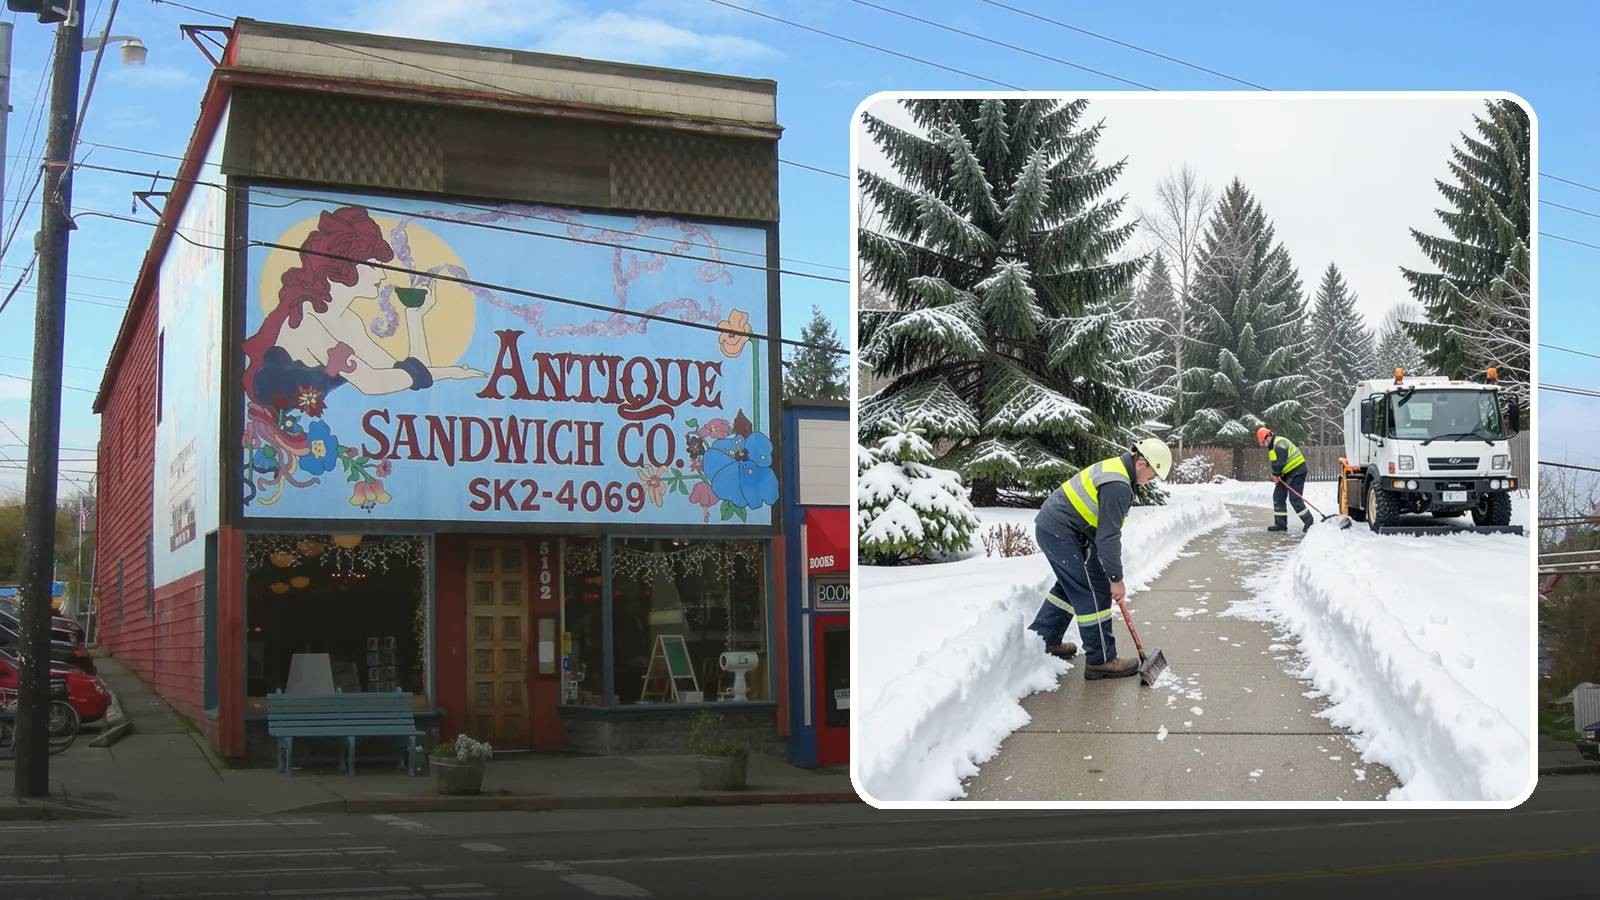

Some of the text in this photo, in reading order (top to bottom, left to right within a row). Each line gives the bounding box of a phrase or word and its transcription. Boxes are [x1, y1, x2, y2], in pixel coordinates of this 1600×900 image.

[476, 329, 723, 420] ANTIQUE
[361, 409, 685, 469] SANDWICH CO.
[468, 477, 645, 513] SK2-4069
[540, 542, 551, 599] 5102
[809, 555, 834, 568] BOOKS
